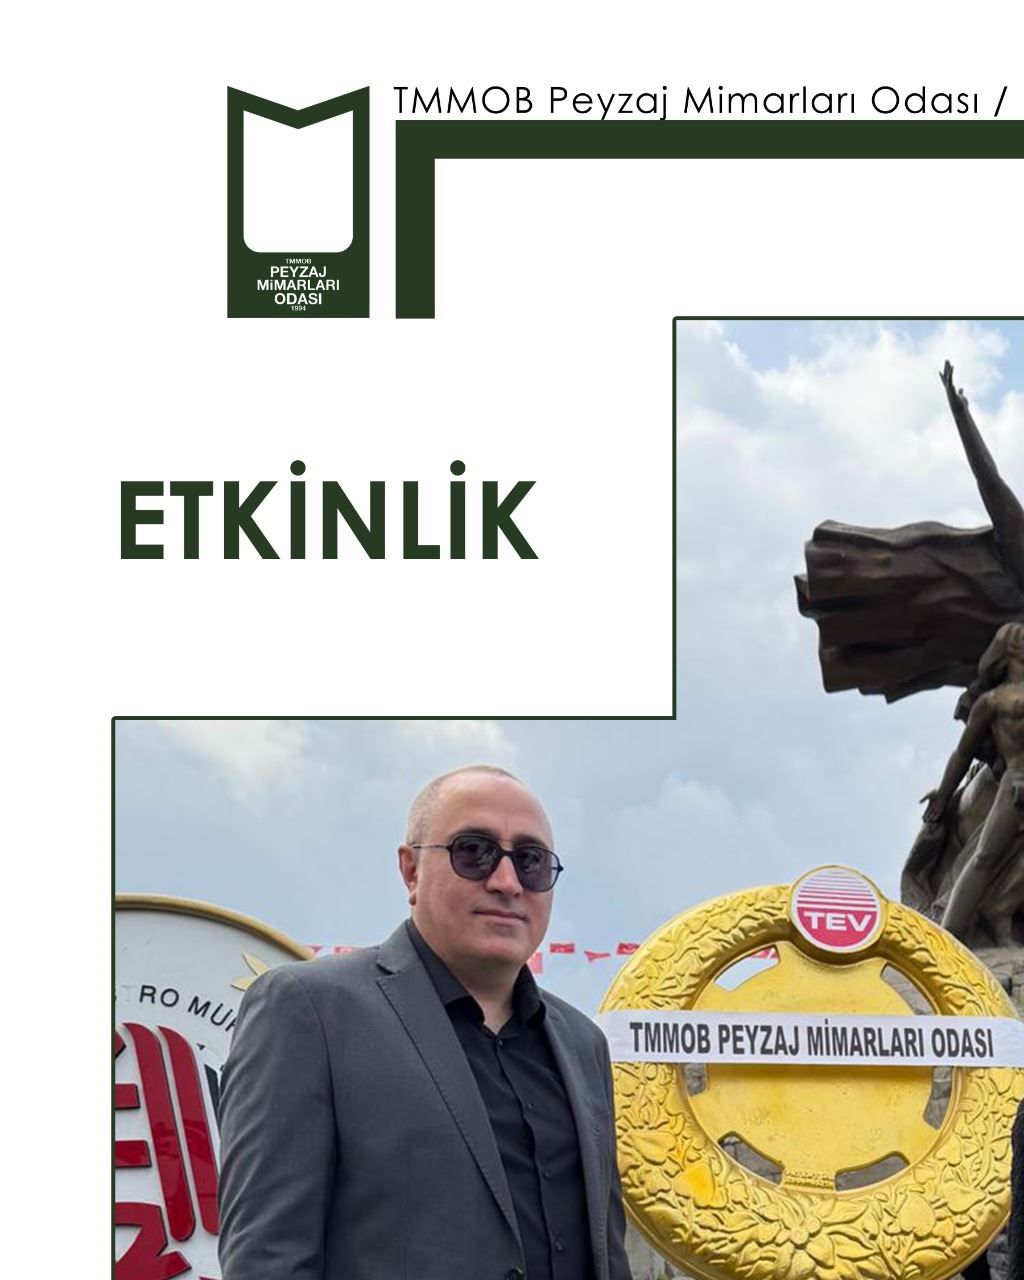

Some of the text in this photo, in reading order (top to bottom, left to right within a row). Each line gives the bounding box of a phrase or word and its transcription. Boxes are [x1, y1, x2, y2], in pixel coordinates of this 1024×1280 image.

[803, 910, 873, 932] TEV
[629, 1018, 994, 1059] TMMOB PEYZAJ MİMARLARI ODASI
